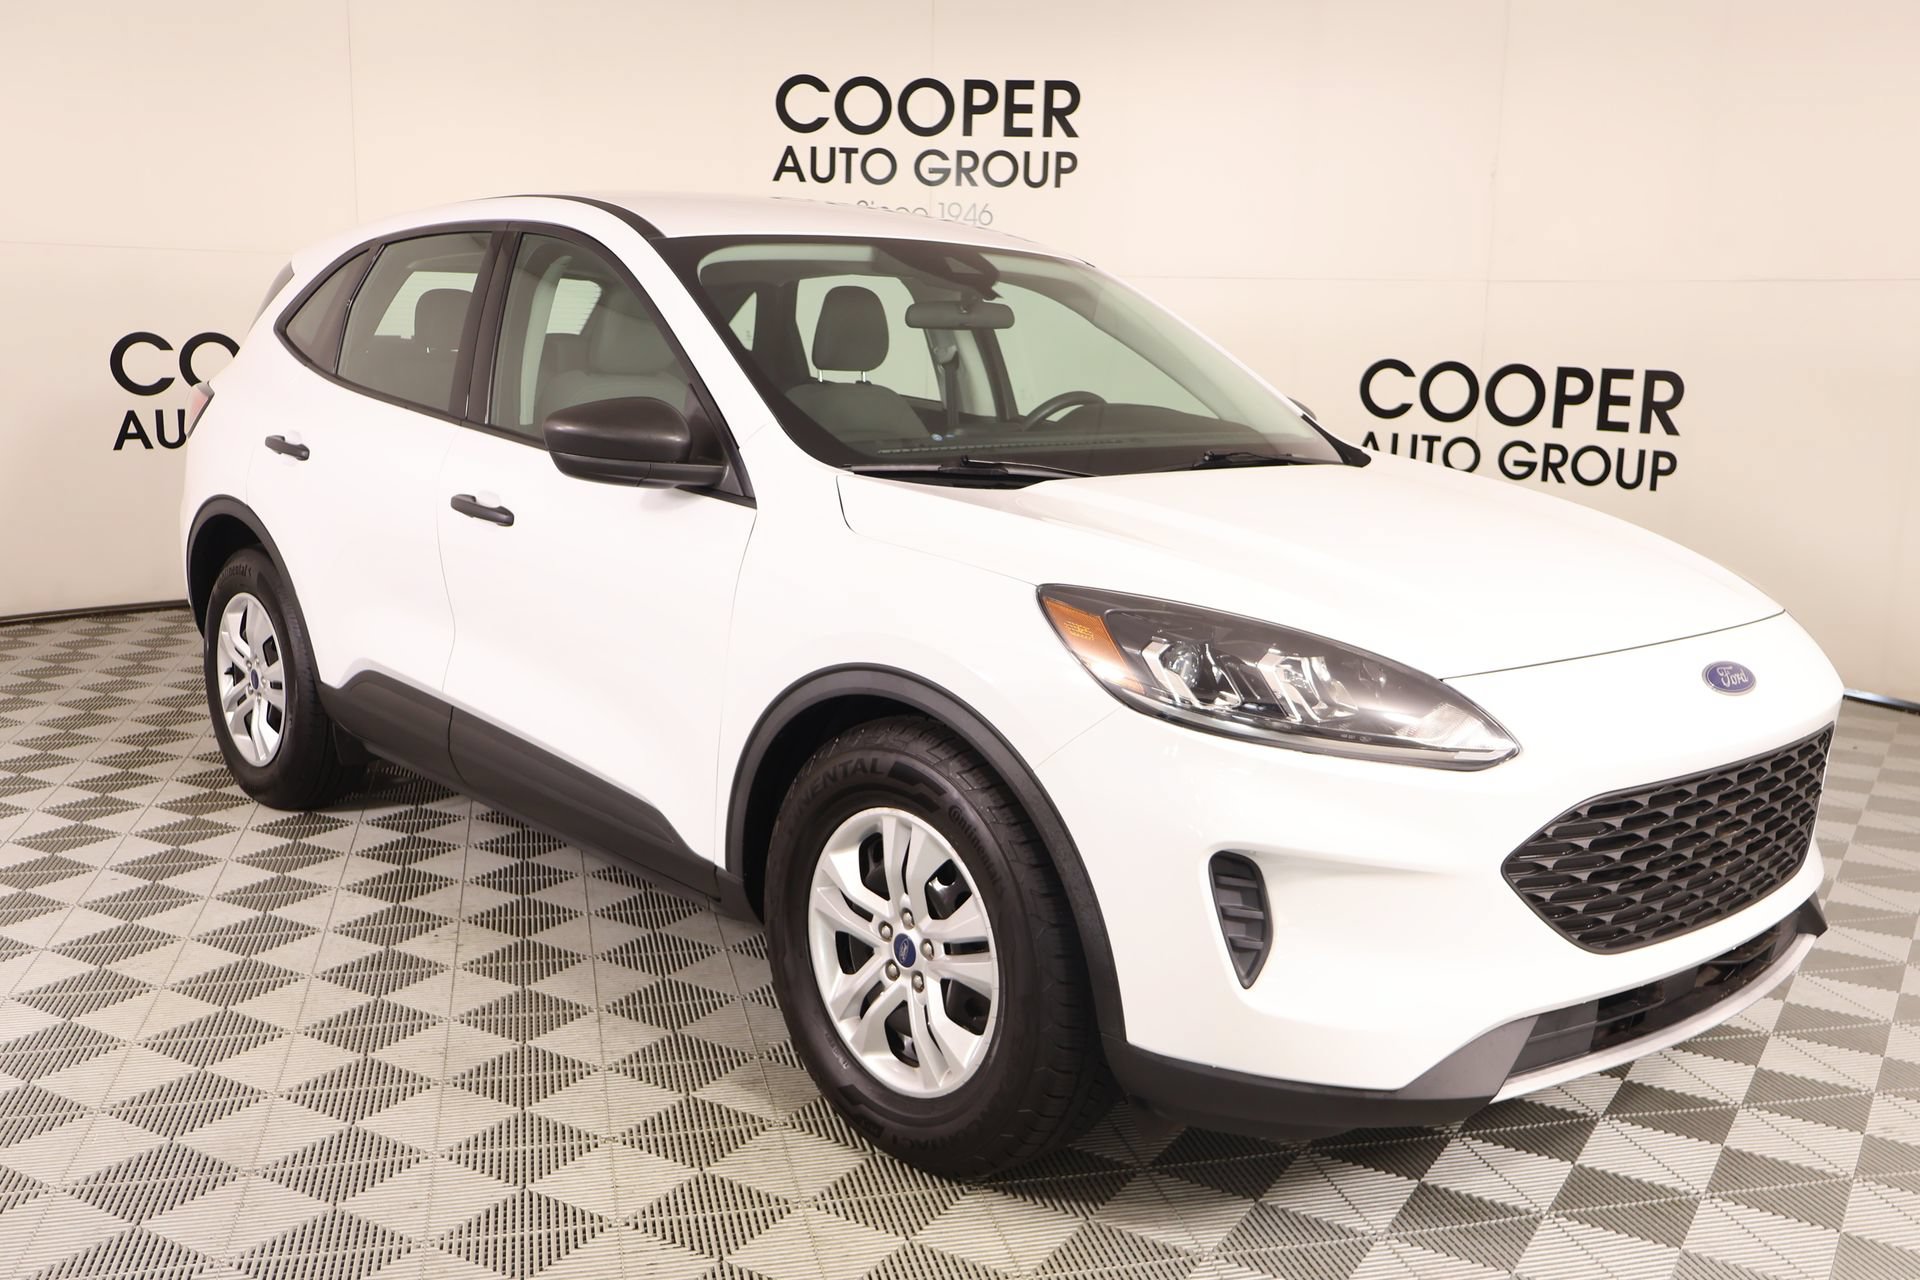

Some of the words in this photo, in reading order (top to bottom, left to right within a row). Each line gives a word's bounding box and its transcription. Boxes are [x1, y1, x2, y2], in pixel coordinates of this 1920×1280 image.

[775, 73, 1081, 138] COOPER
[772, 145, 898, 186] AUTO
[913, 149, 1079, 189] GROUP
[938, 201, 993, 226] 1946
[1359, 358, 1685, 436] COOPER
[113, 408, 187, 451] AU
[1498, 440, 1678, 492] GROUP
[1715, 665, 1750, 688] Ford
